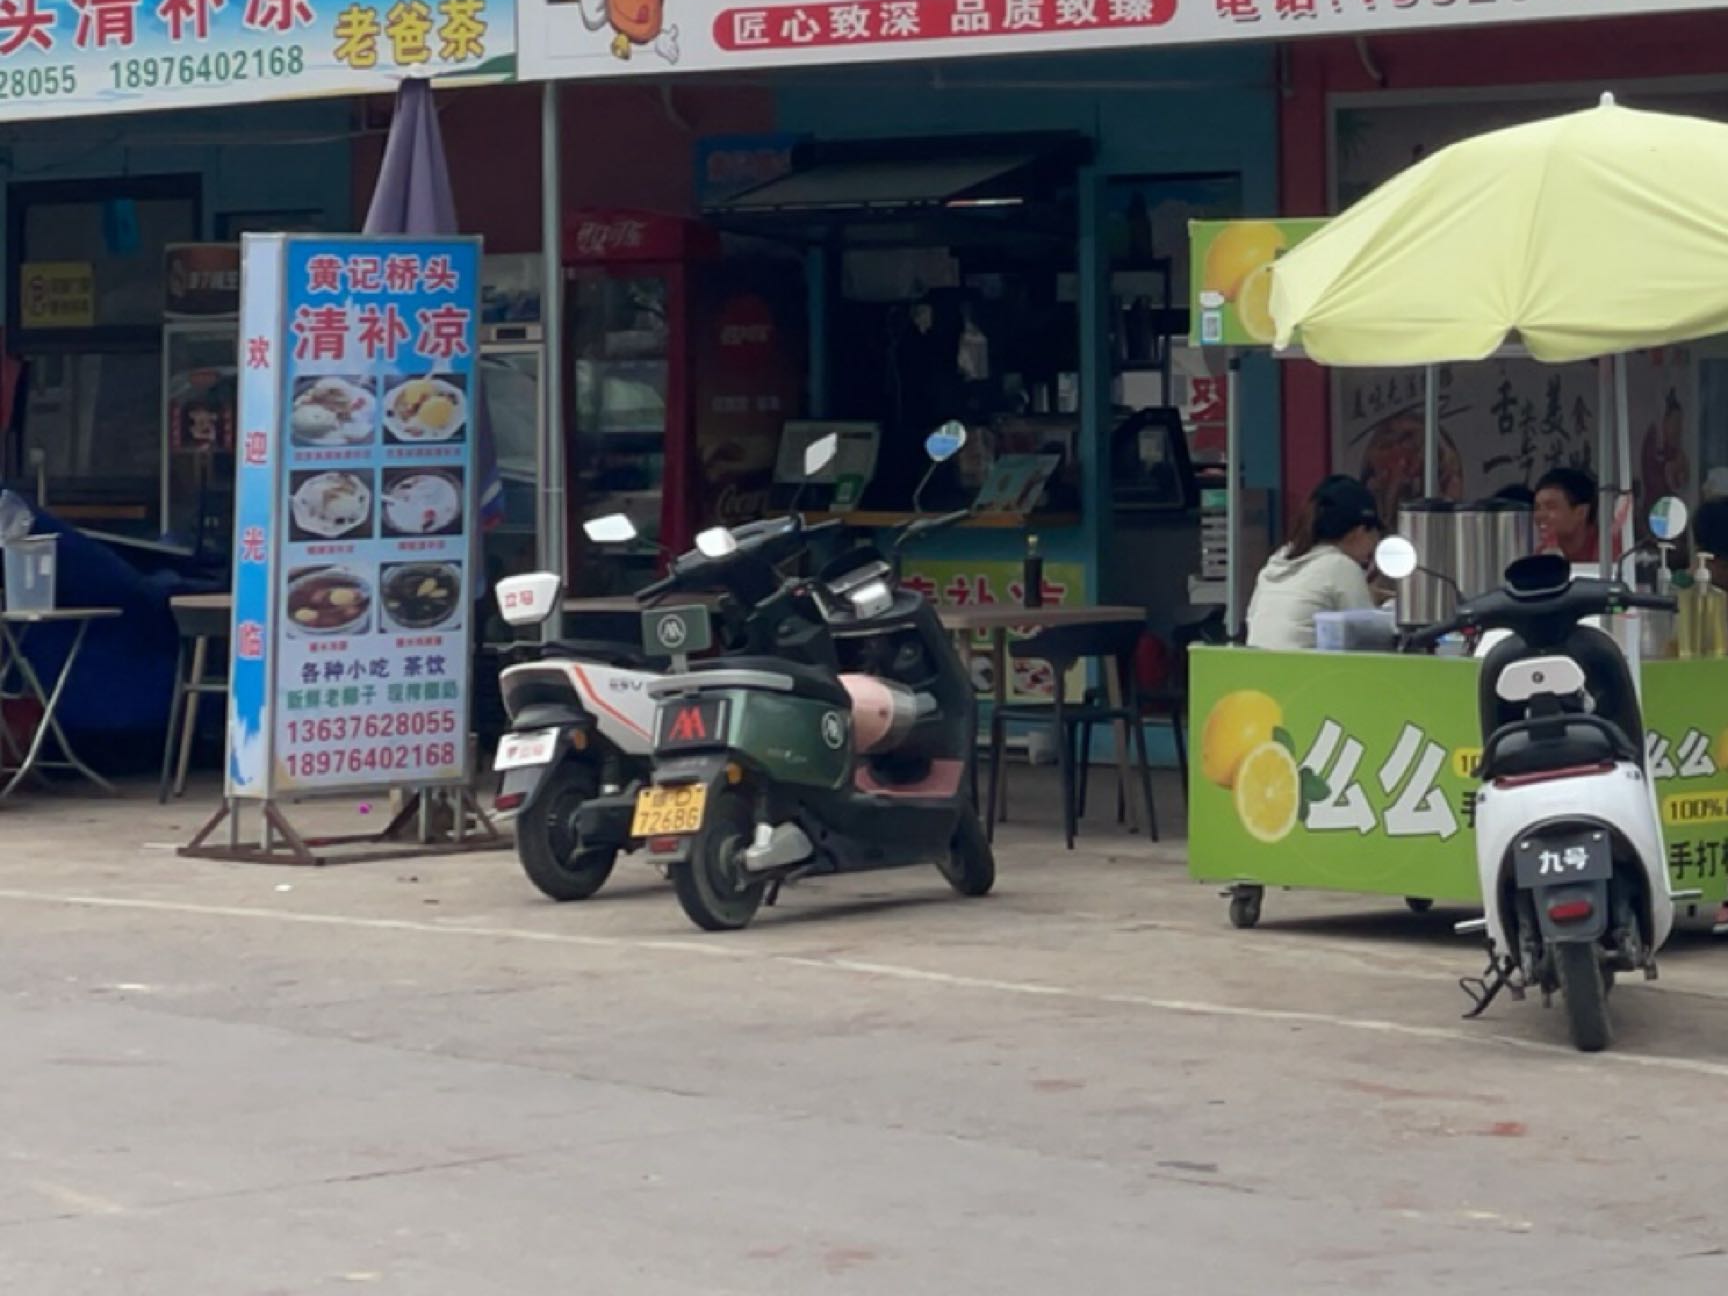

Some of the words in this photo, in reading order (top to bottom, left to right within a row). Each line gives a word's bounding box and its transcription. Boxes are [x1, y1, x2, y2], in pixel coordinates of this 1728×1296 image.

[733, 1, 920, 45] 匠心致深
[110, 45, 304, 90] 18976402168
[308, 257, 458, 292] 黄记桥头
[293, 306, 469, 361] 清补凉
[239, 336, 270, 657] 欢迎光临
[302, 657, 390, 685] 各种小吃
[287, 710, 456, 744] 13637628055
[287, 742, 456, 777] 18976402168
[1305, 719, 1458, 840] 么么
[1539, 847, 1590, 874] 九号
